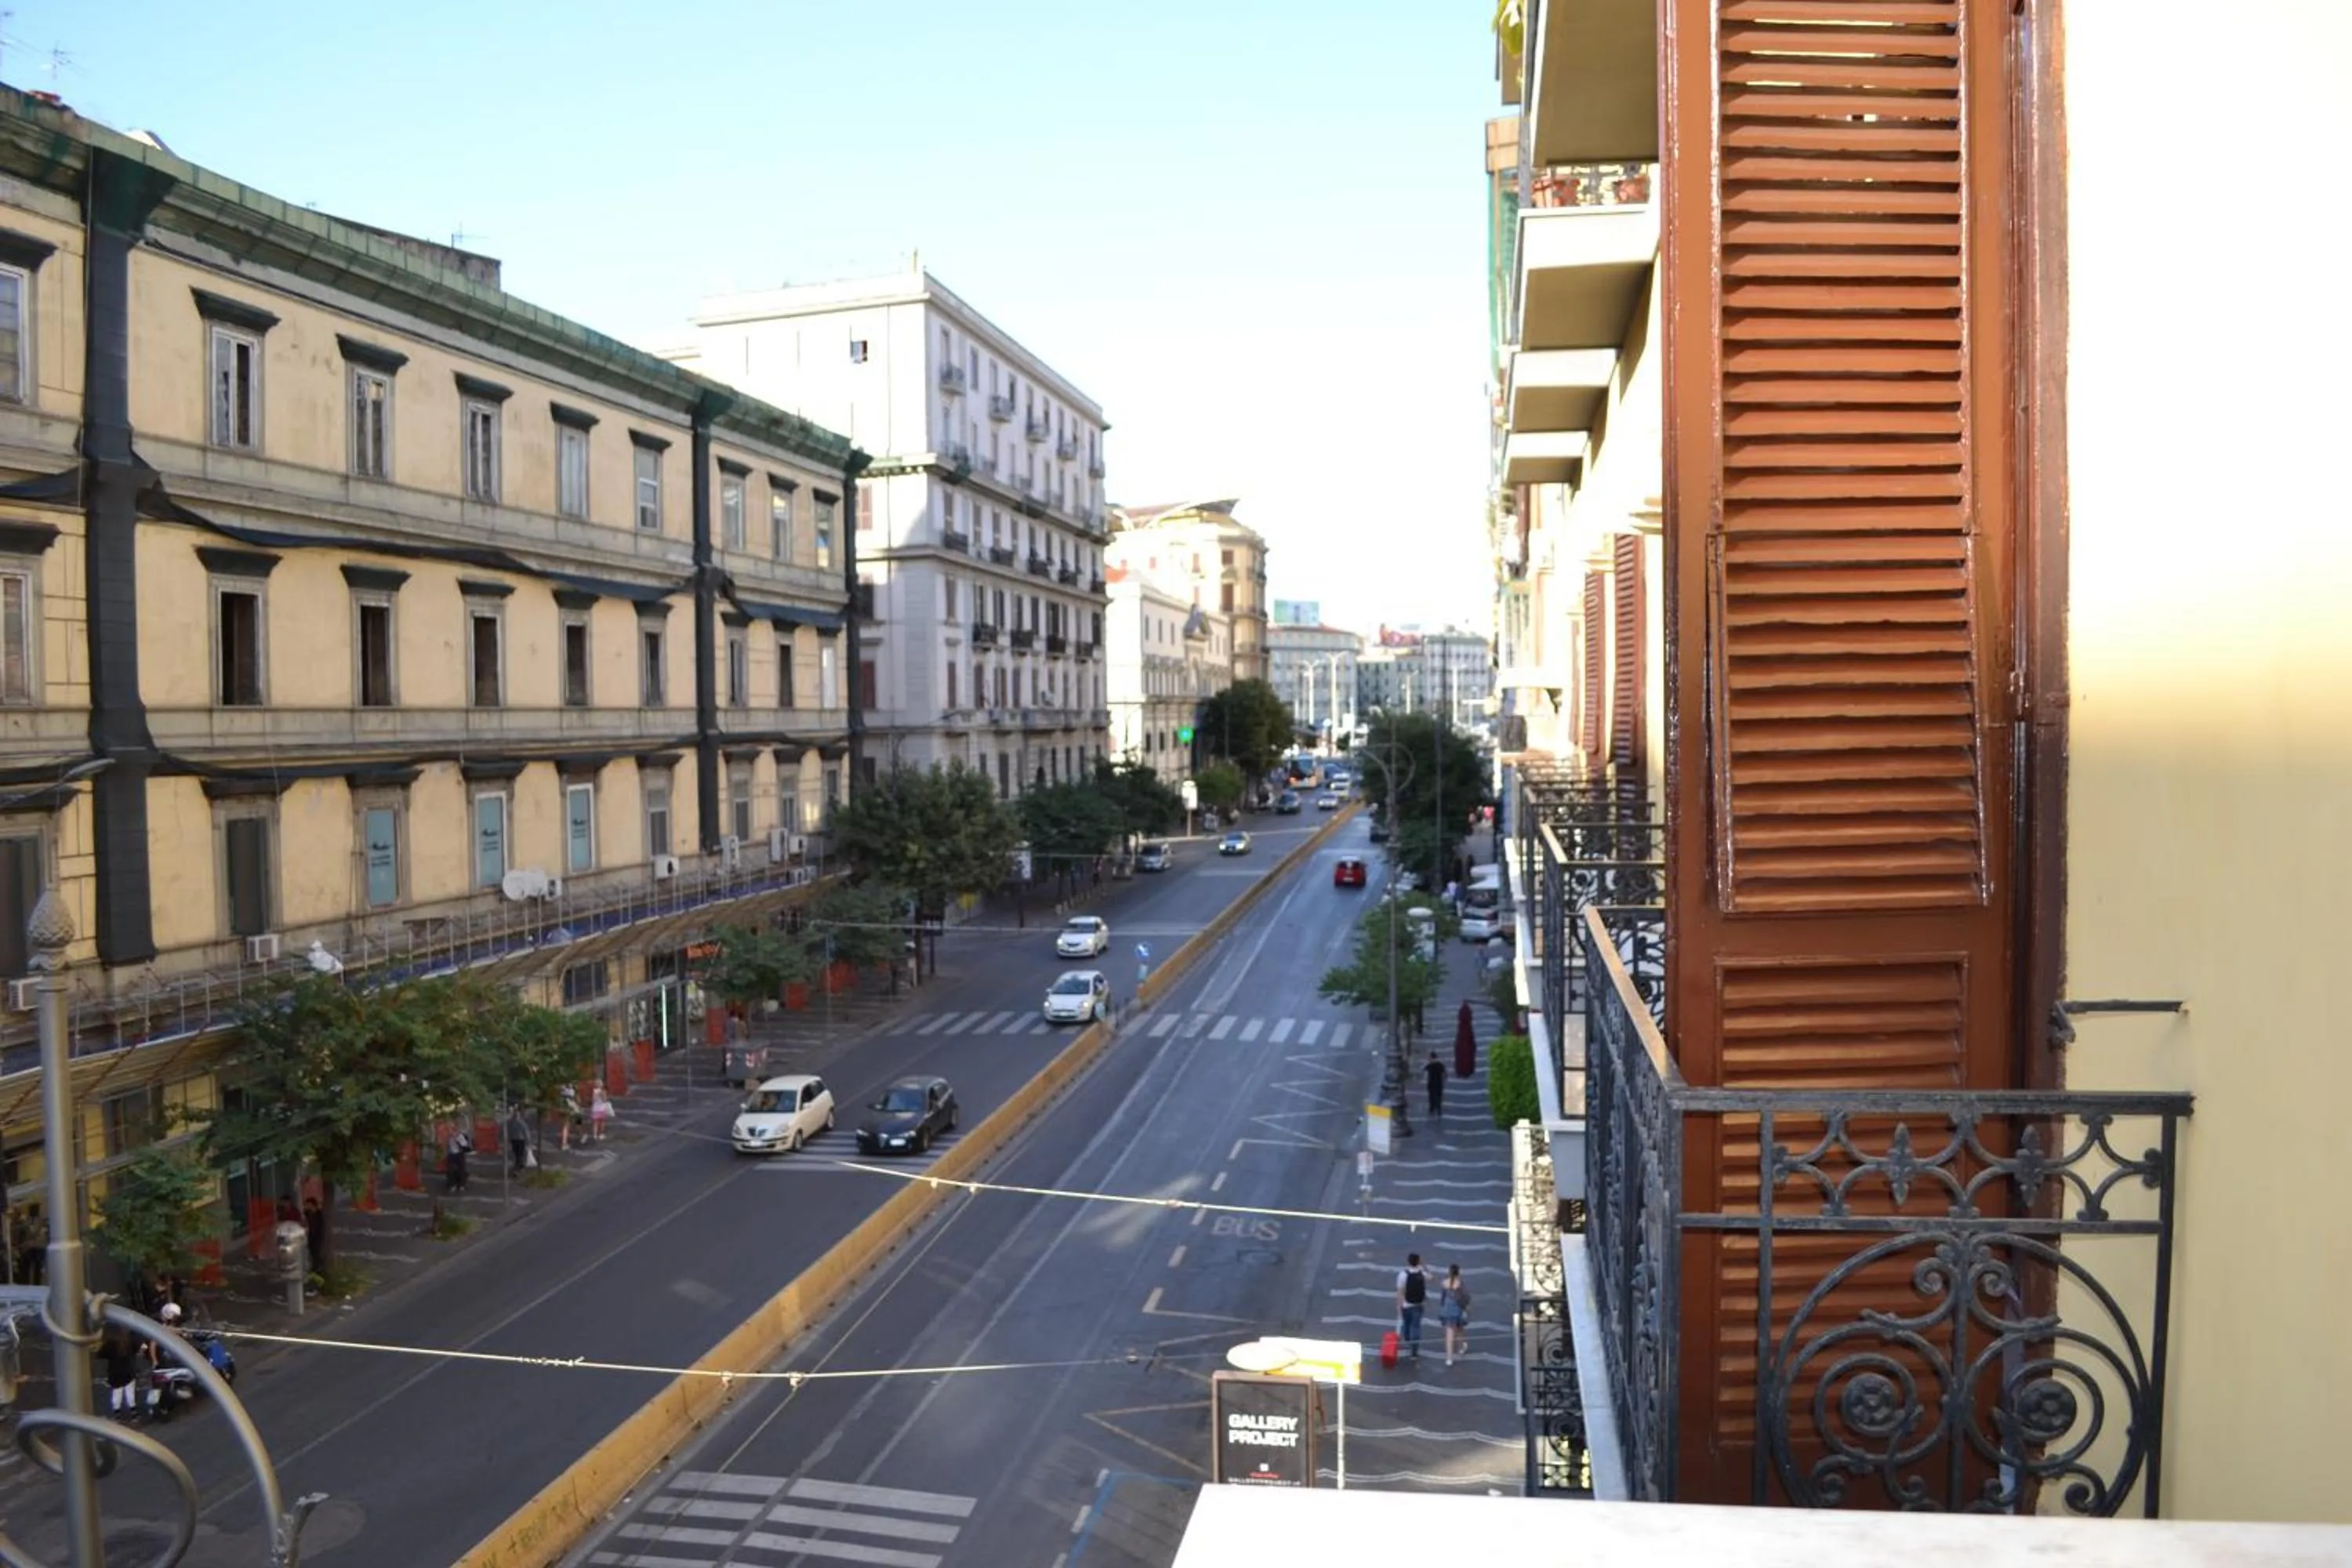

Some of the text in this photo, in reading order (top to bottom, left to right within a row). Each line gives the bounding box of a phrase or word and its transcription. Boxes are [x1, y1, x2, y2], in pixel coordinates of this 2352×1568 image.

[1211, 1215, 1281, 1240] BUS
[1229, 1414, 1298, 1431] GALLERY
[1229, 1430, 1299, 1446] PROJECT
